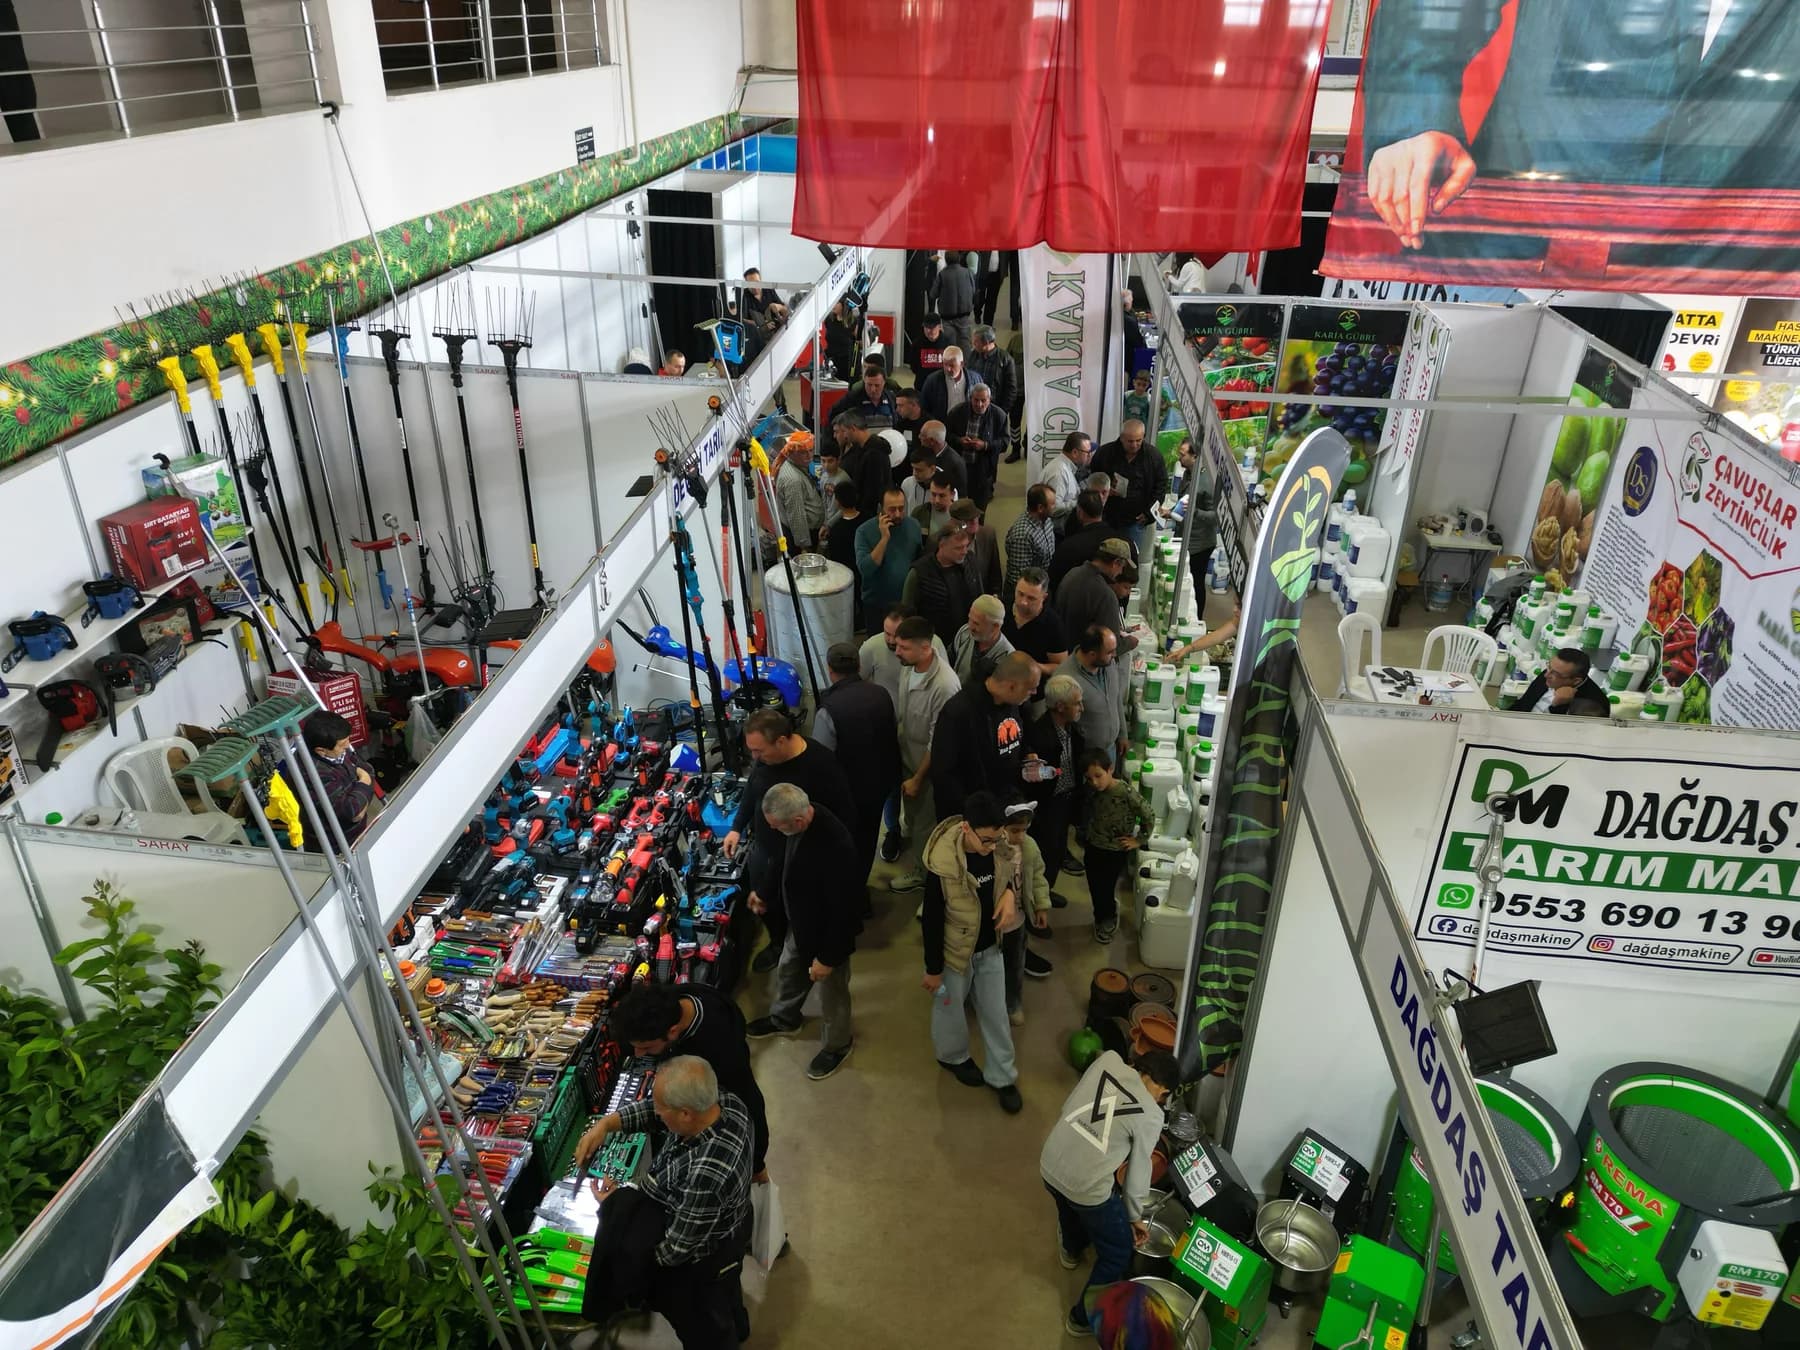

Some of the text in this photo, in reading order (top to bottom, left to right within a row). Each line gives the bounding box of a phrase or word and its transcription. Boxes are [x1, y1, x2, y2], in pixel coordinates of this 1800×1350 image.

[1714, 454, 1798, 531] ÇAVUŞLAR
[1704, 482, 1788, 560] ZEYTİNCİLİK
[1594, 777, 1798, 854] DAĞDAŞ
[1462, 837, 1668, 888] TARIM
[1462, 923, 1572, 946] dadaşmakine
[1479, 891, 1587, 923] 0553
[1601, 902, 1681, 930] 690
[1697, 909, 1748, 935] 13
[1622, 942, 1731, 960] dağdaşmakine
[1390, 953, 1486, 1216] DAĞDAŞ
[1589, 1170, 1624, 1217] RM 170
[1602, 1153, 1664, 1217] REMA
[1728, 1265, 1780, 1281] RM 170
